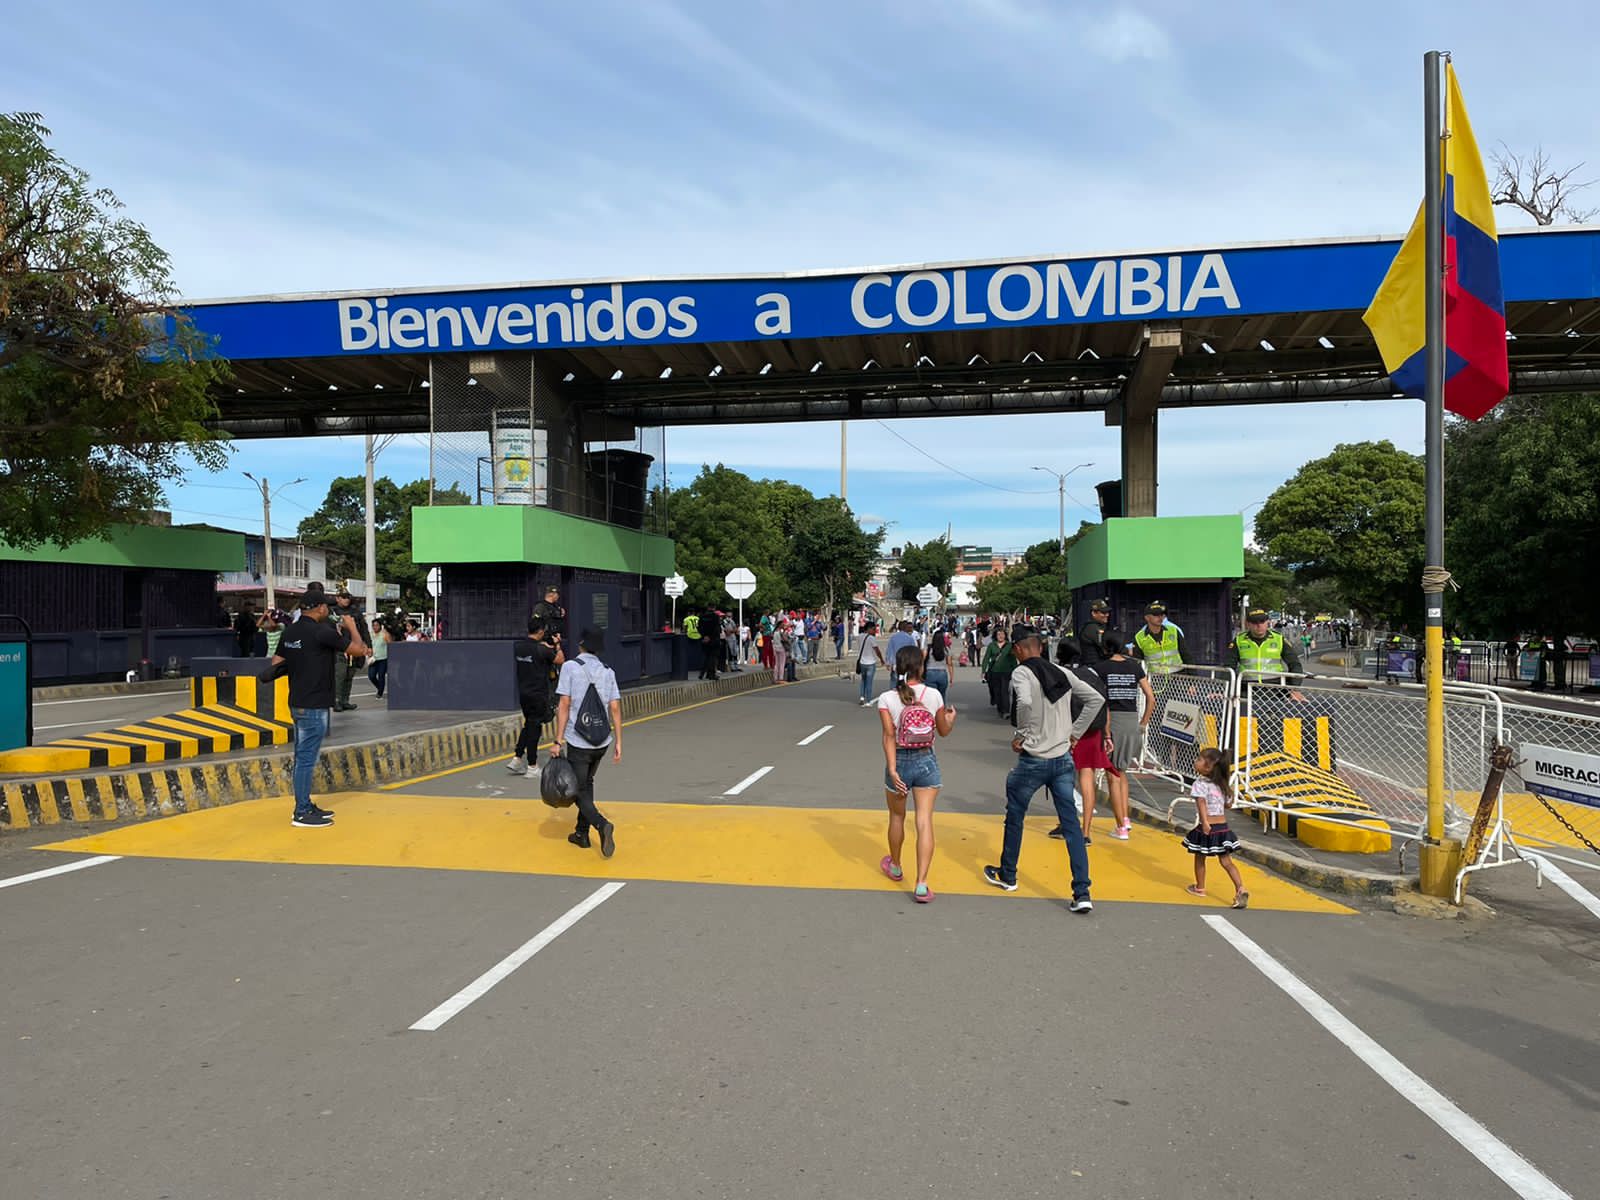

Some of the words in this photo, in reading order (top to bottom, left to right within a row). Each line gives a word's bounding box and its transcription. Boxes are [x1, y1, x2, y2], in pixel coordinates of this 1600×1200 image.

[338, 283, 698, 350] Bienvenidos
[753, 292, 792, 335] a
[850, 253, 1241, 329] COLOMBIA
